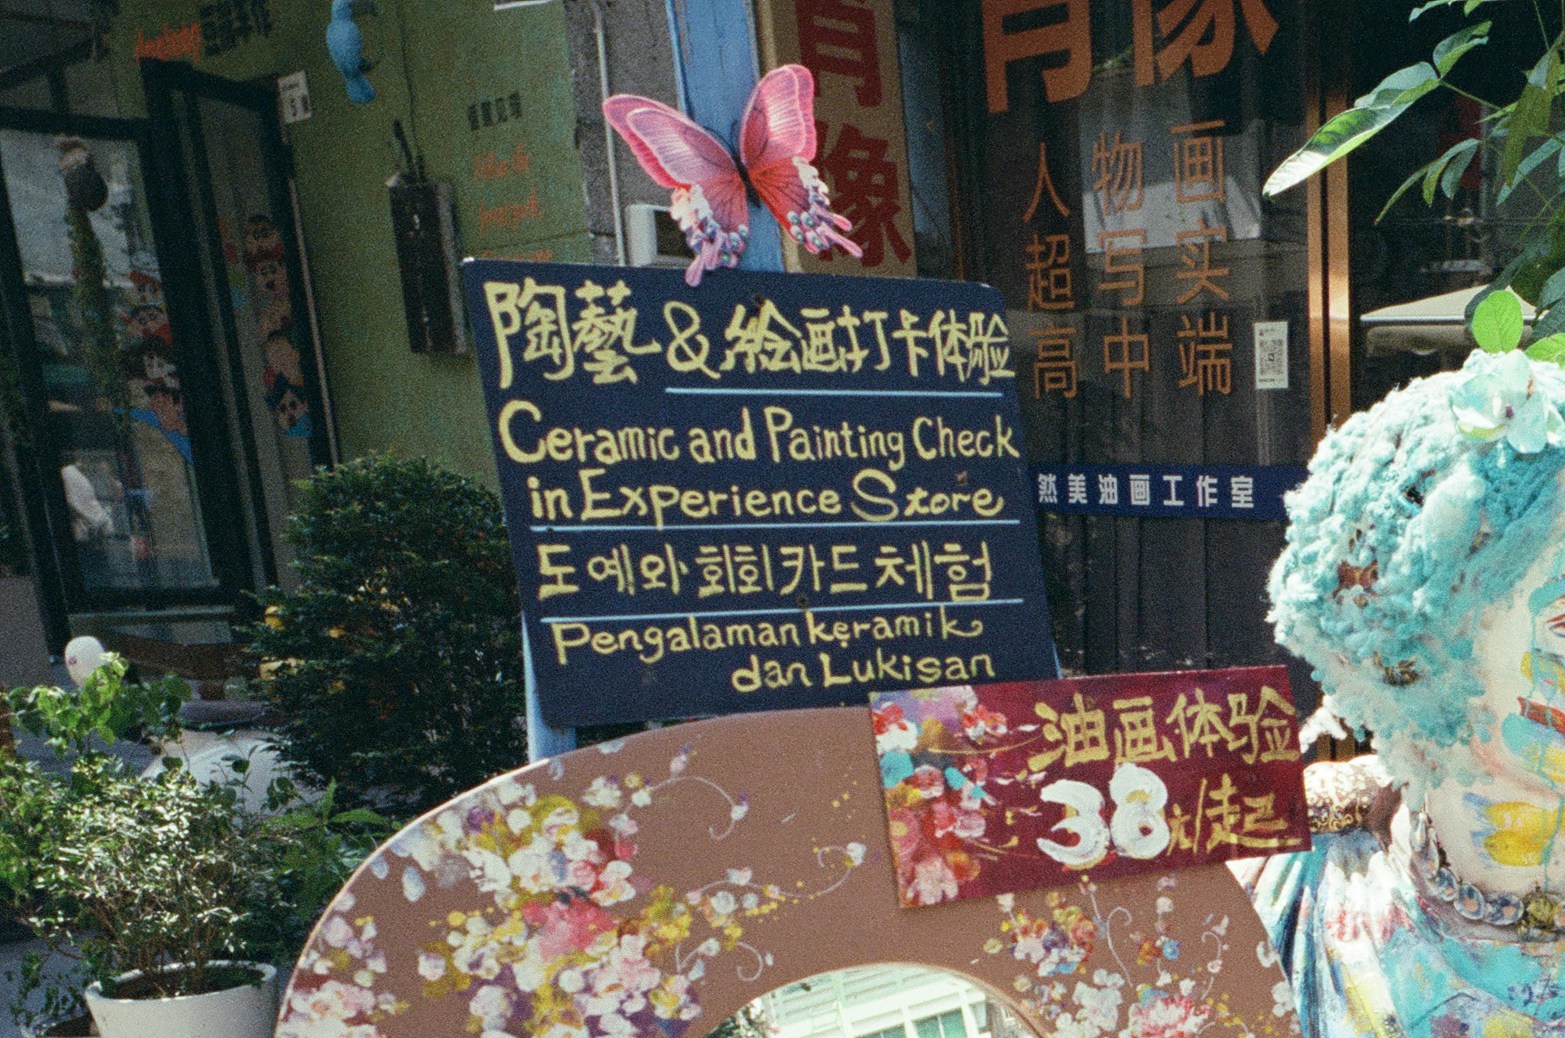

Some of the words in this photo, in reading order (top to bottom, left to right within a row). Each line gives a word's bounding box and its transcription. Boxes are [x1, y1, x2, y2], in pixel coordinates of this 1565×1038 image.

[1022, 119, 1227, 224] 人物画
[1025, 217, 1231, 311] 超写实
[1028, 311, 1233, 400] 高中端
[499, 399, 680, 465] Ceramic
[688, 406, 756, 464] and
[763, 406, 905, 471] Painting
[911, 413, 1021, 461] Check
[527, 475, 574, 521] in
[578, 467, 842, 531] Experience
[851, 468, 1004, 522] Store
[551, 614, 801, 665] Pengalaman
[731, 654, 812, 693] dan
[819, 647, 996, 689] Lukisan
[1027, 685, 1302, 773] 油画体验
